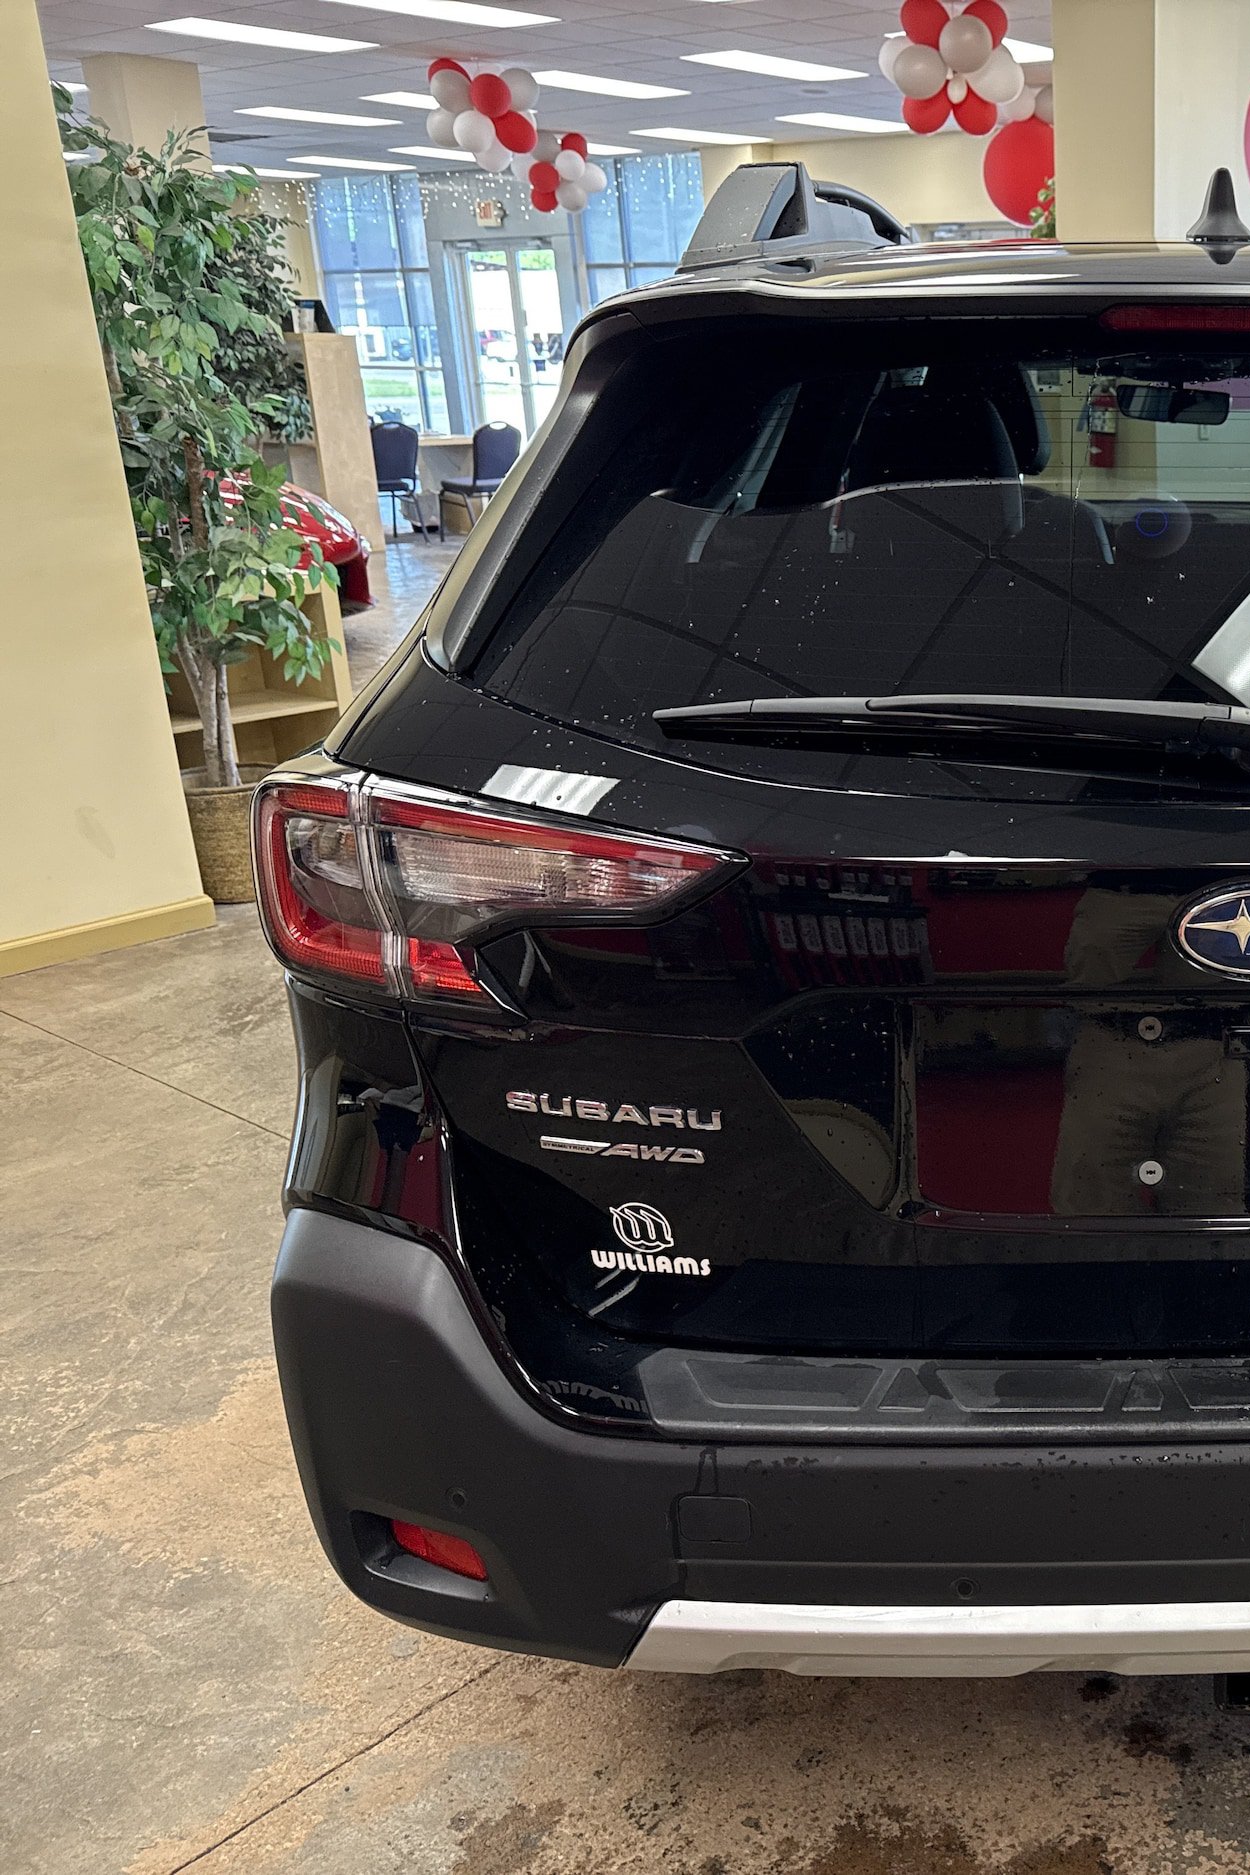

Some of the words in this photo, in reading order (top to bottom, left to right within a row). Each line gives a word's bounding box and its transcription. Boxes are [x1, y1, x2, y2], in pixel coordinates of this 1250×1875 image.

[505, 1090, 722, 1131] SUBARU
[600, 1143, 706, 1164] AWD
[590, 1249, 711, 1276] WILLIAMS
